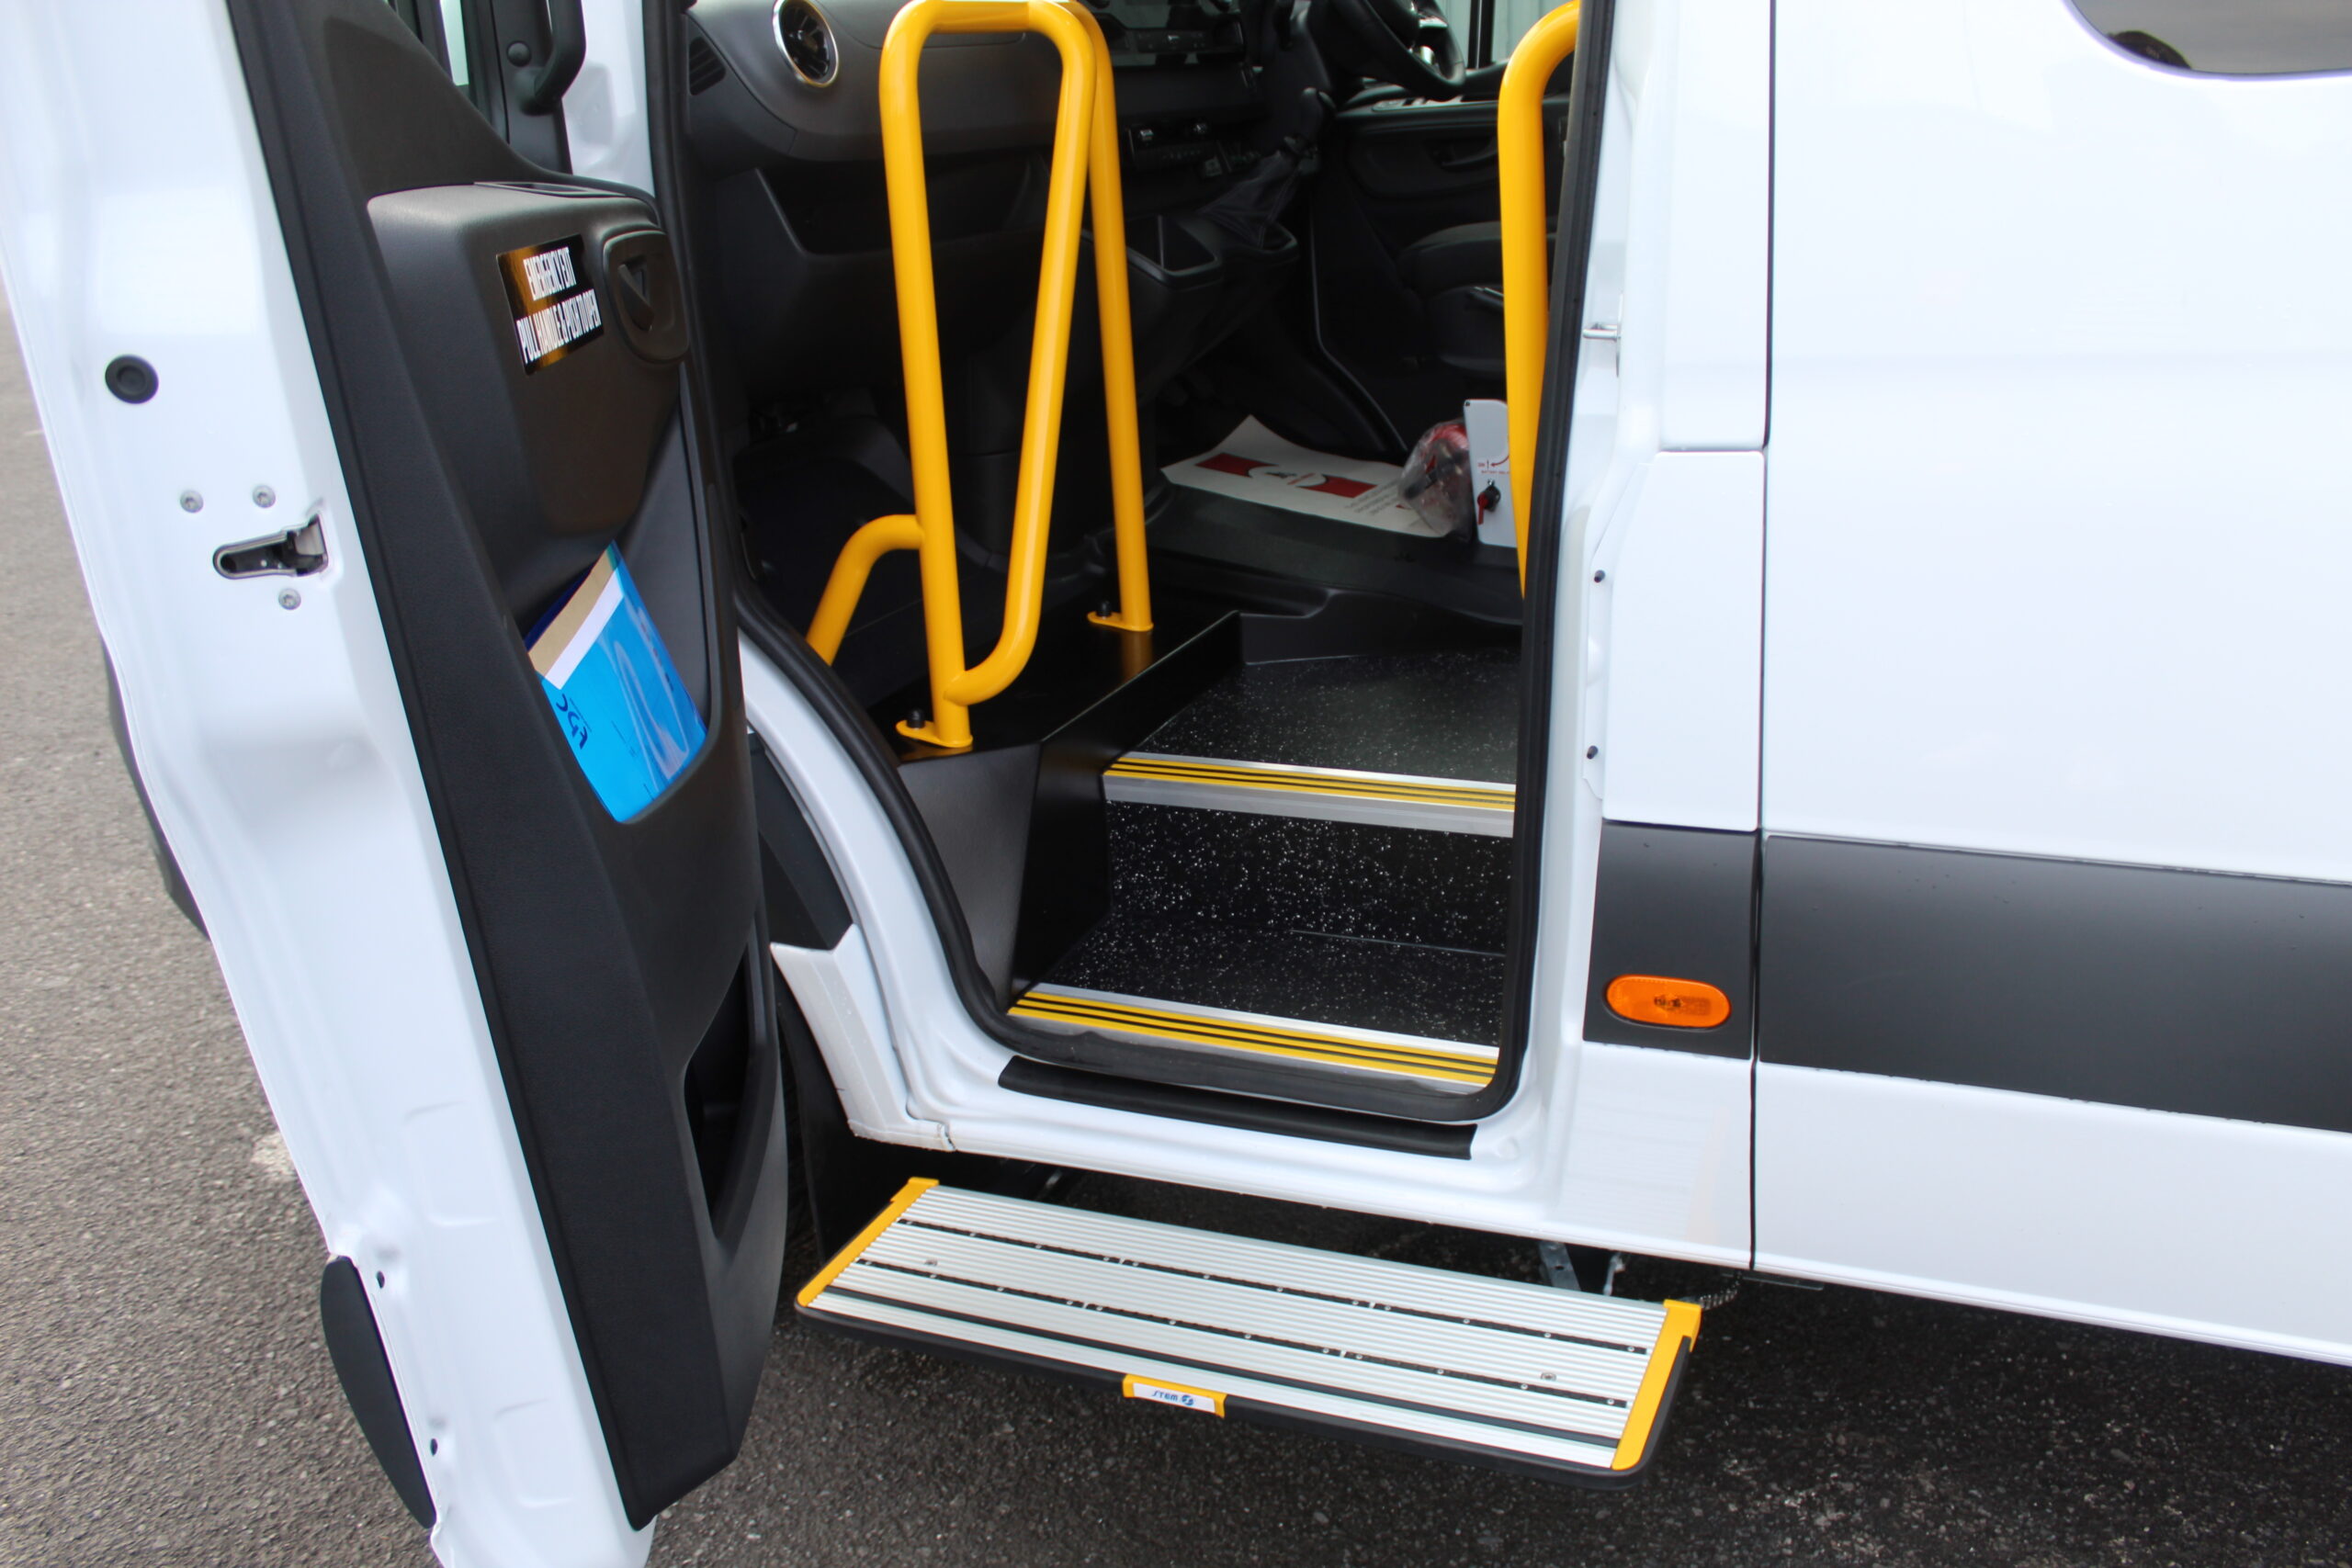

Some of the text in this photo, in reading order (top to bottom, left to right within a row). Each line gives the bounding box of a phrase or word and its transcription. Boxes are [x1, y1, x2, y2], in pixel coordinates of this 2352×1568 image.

[523, 246, 576, 301] EMERGENCY EXIT
[532, 304, 564, 356] HANDLE
[561, 297, 582, 341] PUSH
[575, 293, 590, 333] TO
[582, 288, 602, 331] OPEN
[515, 314, 541, 365] PULL
[1151, 1390, 1178, 1402] STEM
